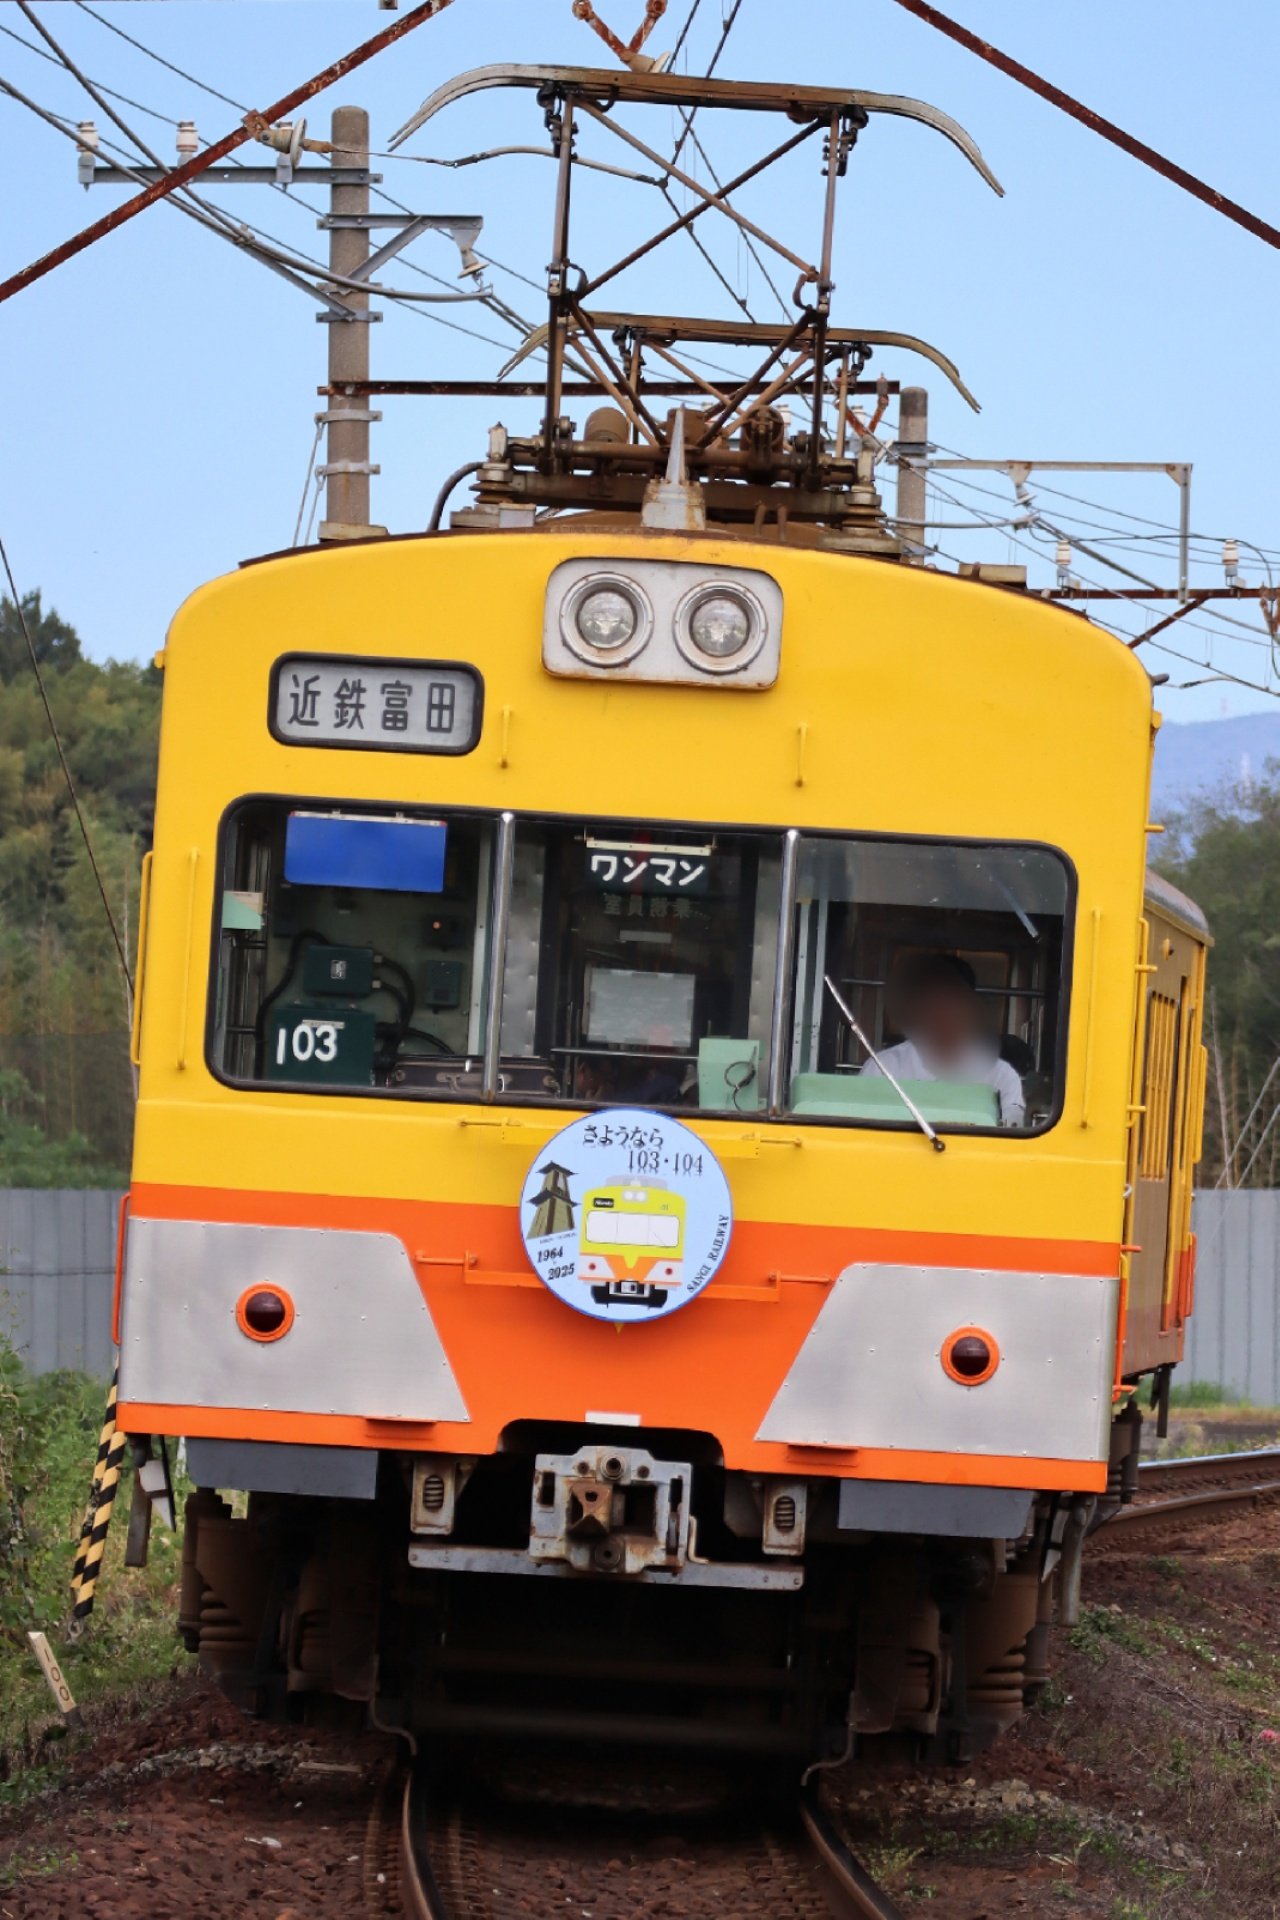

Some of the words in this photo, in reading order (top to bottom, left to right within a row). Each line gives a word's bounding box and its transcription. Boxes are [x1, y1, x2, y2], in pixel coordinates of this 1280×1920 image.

[287, 674, 456, 733] 近鉄富田
[590, 855, 705, 886] ワンマン
[276, 1023, 338, 1064] 103
[582, 1124, 665, 1148] さようなら
[537, 1245, 563, 1263] 1964
[686, 1264, 712, 1293] SANGI
[707, 1214, 729, 1262] RAILWAY
[548, 1262, 575, 1280] 2025
